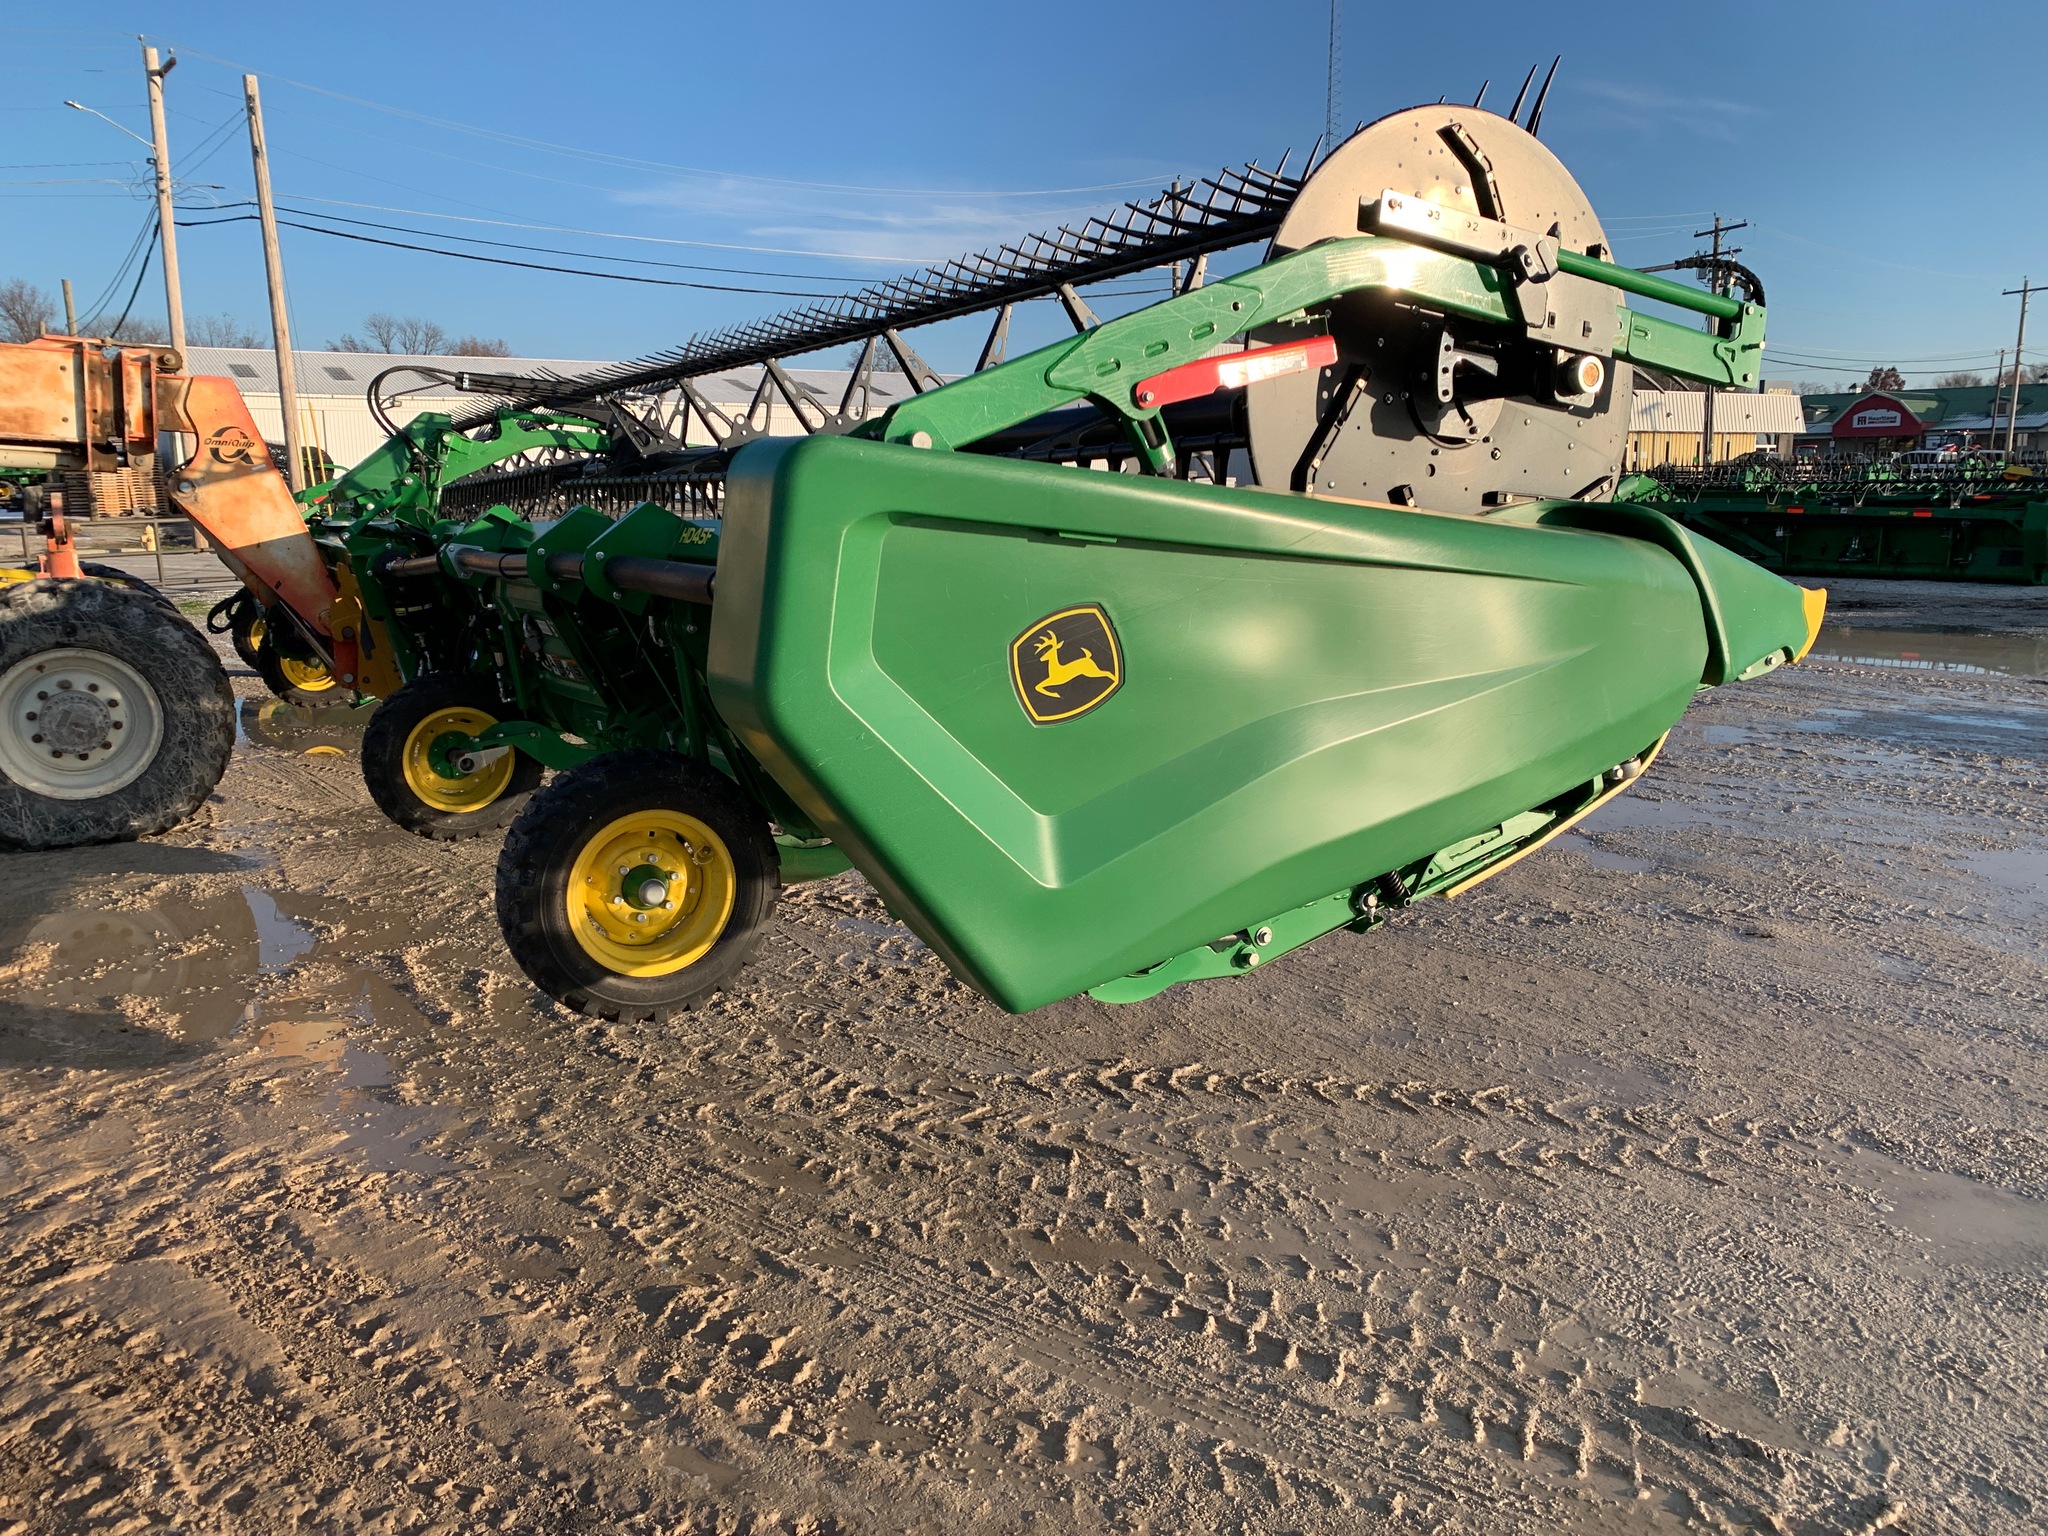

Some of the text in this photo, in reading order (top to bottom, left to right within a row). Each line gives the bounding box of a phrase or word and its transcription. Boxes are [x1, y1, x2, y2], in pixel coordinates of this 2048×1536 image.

[1434, 211, 1440, 220] 3
[1473, 222, 1479, 232] 2
[204, 438, 255, 448] OmniQuip
[679, 527, 716, 545] HD45F
